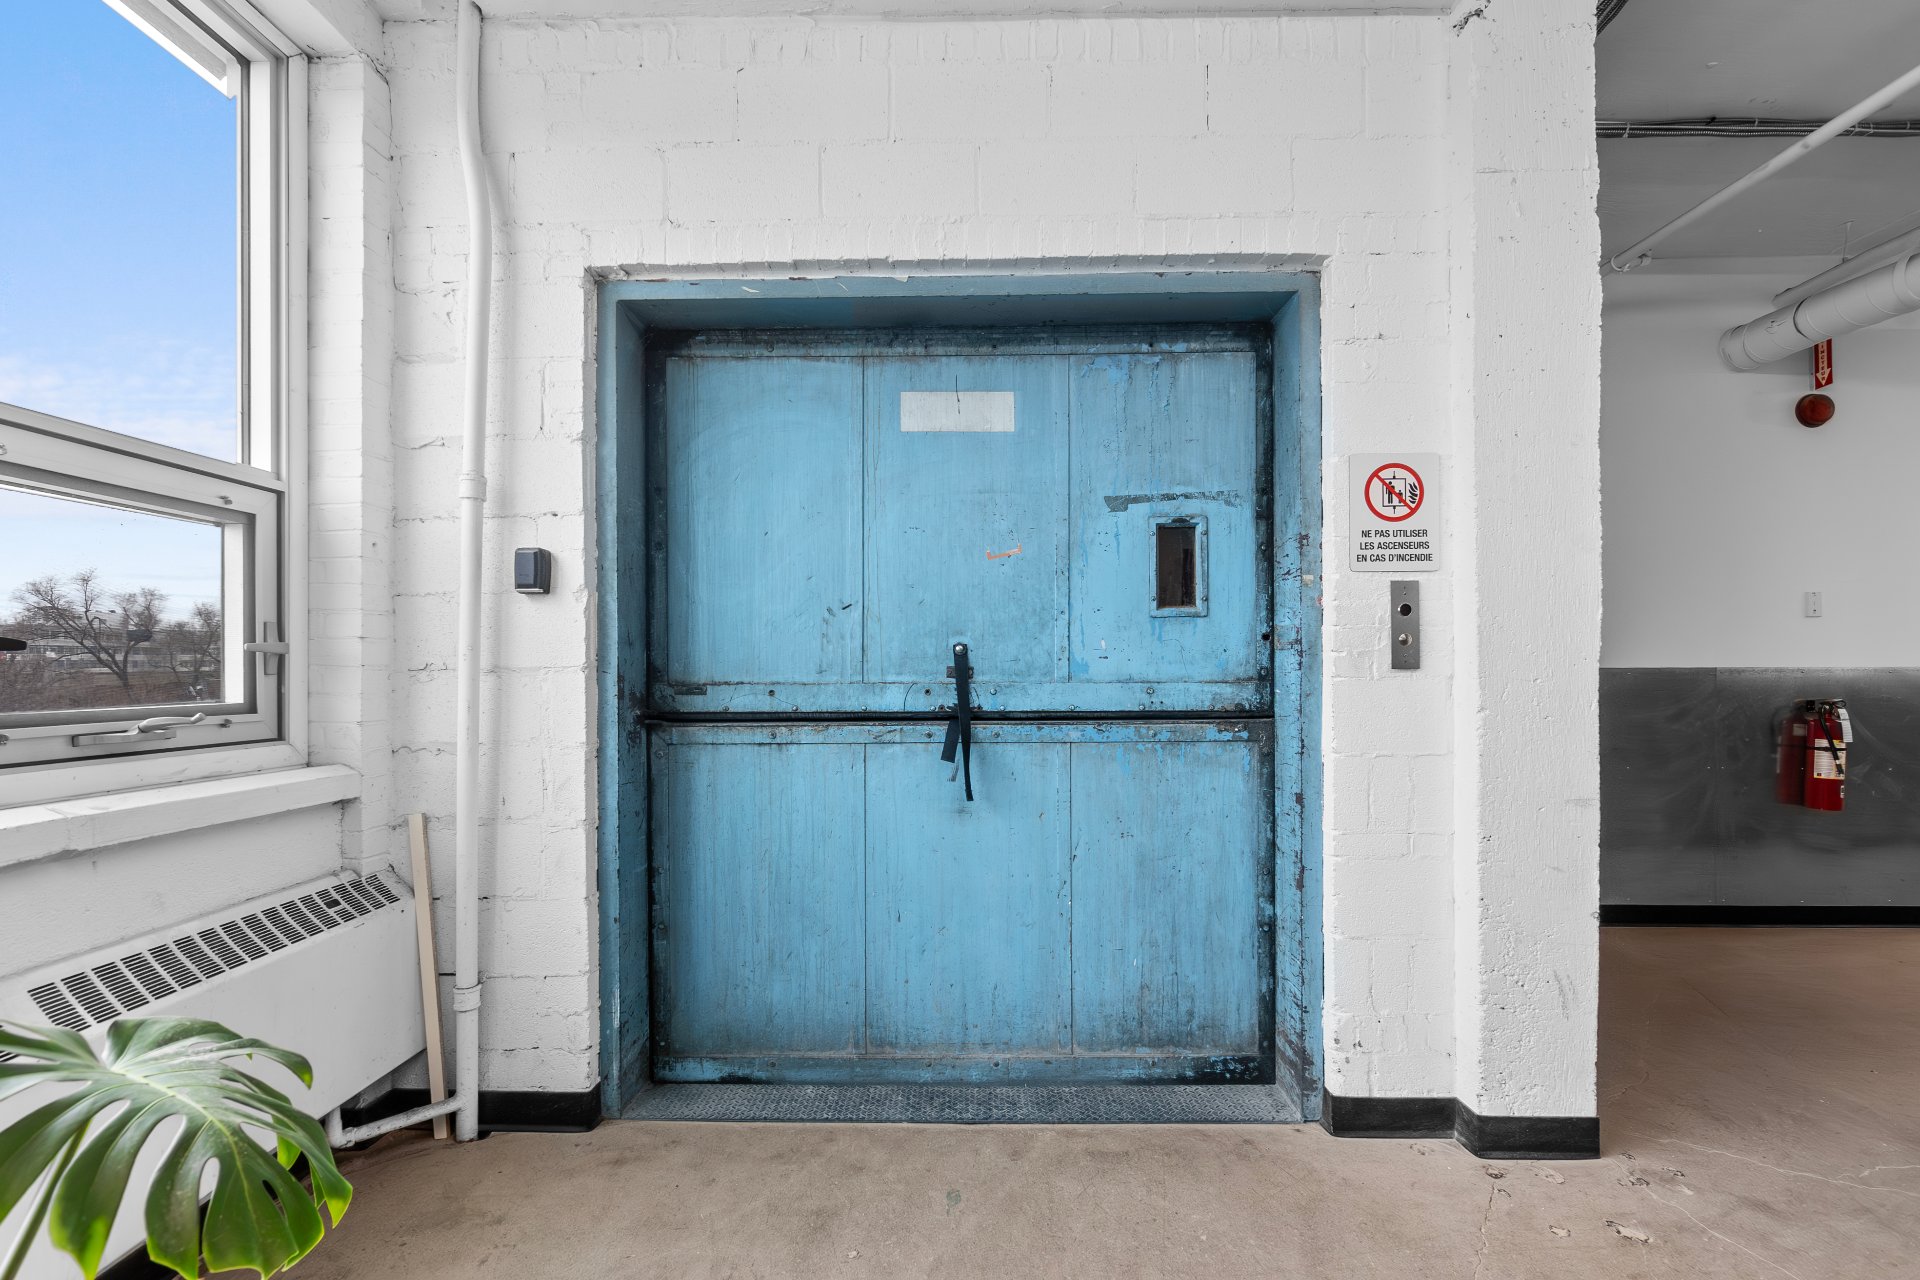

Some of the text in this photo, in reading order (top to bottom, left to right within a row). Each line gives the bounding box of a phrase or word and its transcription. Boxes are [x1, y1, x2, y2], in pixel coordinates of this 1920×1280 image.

[1361, 529, 1428, 538] NE PAS UTILISER
[1359, 541, 1430, 550] LES ASCENSEURS
[1356, 553, 1433, 562] EN CAS D'INCENDIE
